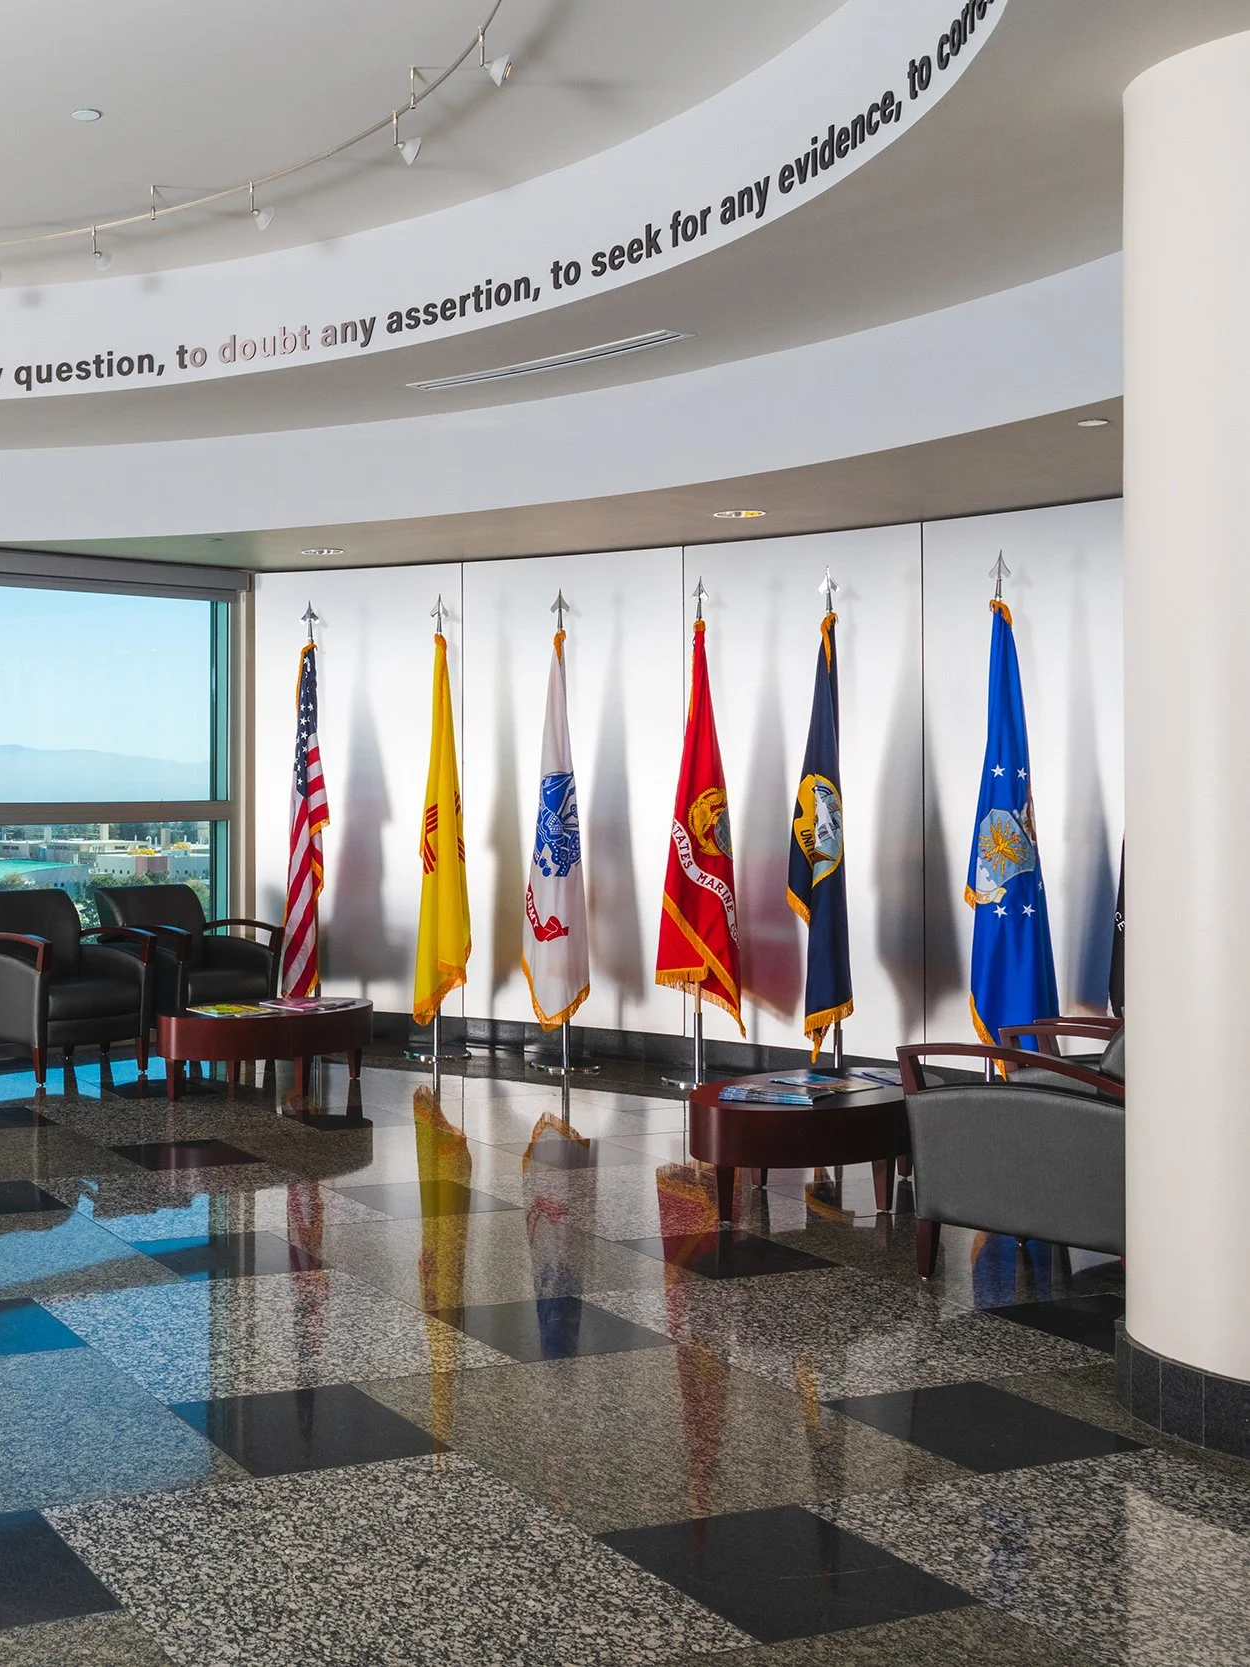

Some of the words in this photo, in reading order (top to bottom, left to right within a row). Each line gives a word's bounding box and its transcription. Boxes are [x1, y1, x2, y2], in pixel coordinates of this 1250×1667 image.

[14, 350, 166, 391] question,
[176, 343, 207, 369] to
[218, 324, 311, 364] doubt
[320, 316, 377, 347] any
[386, 274, 542, 334] assertion,
[550, 259, 581, 290] to
[591, 223, 662, 277] seek
[670, 206, 711, 248] for
[720, 175, 770, 225] any
[779, 90, 902, 194] evidence,
[907, 55, 931, 100] to
[937, 0, 995, 70] corr
[527, 891, 539, 928] ARMY
[696, 872, 734, 912] MARINE
